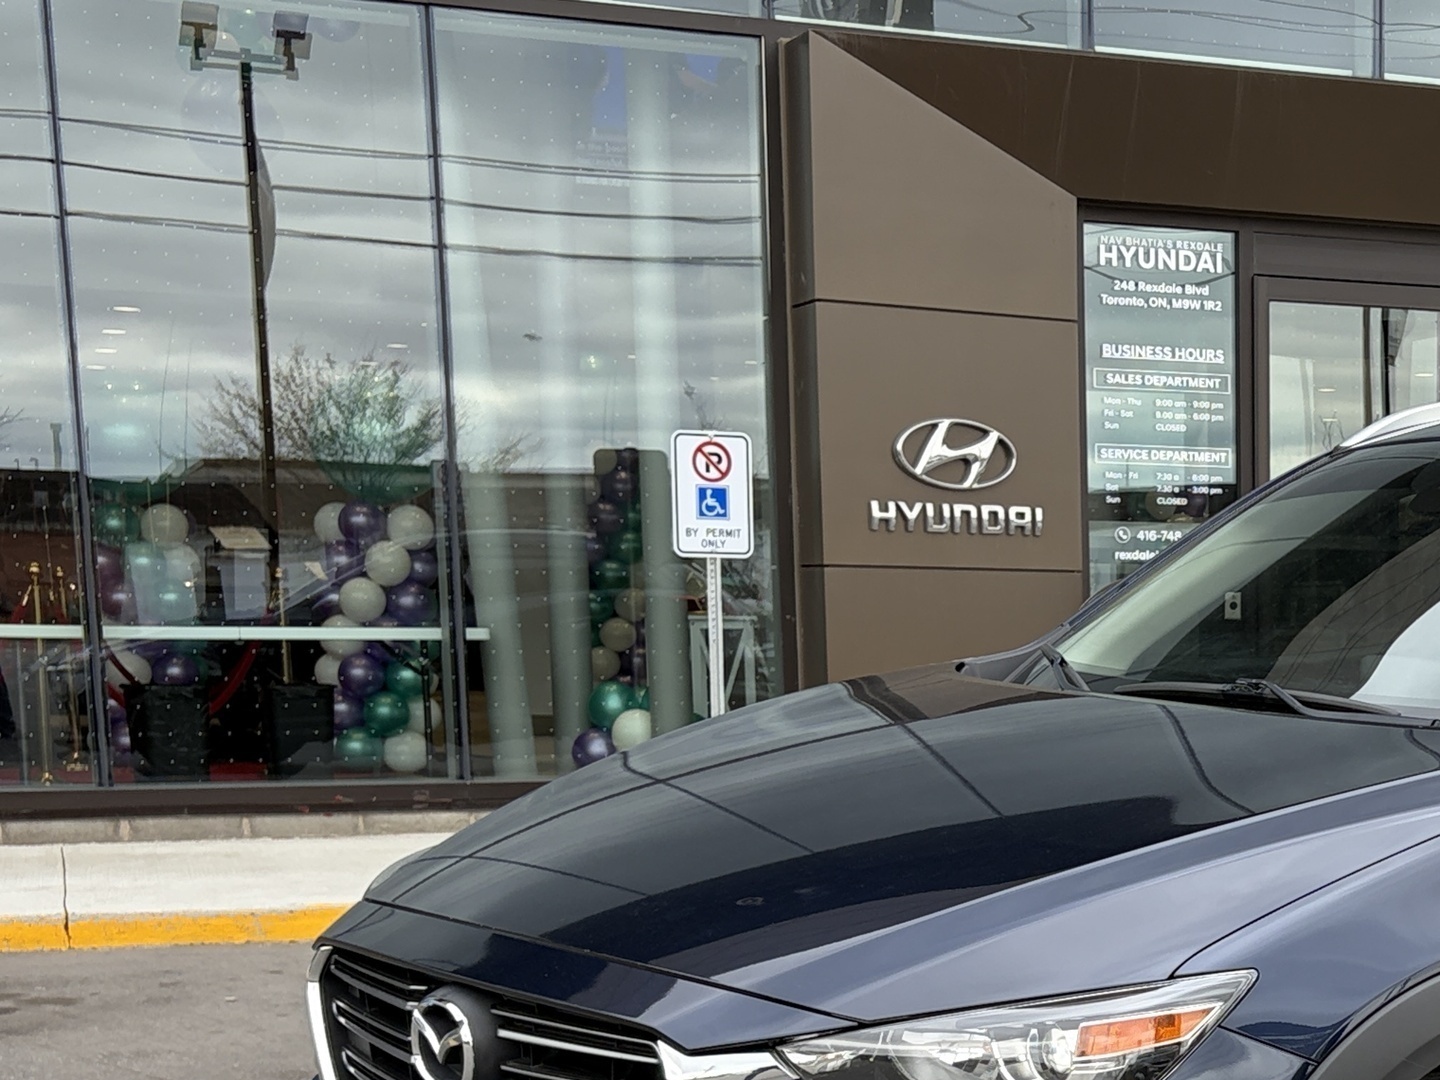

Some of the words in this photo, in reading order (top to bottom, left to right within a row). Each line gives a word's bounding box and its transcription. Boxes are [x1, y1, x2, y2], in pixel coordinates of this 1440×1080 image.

[1100, 235, 1123, 246] NAV
[1125, 236, 1173, 249] BHATIA'S
[1176, 240, 1224, 252] REXDALE
[1100, 244, 1223, 274] HYUNDAI
[1113, 280, 1136, 292] 248
[1137, 281, 1183, 294] Rexdale
[1185, 284, 1210, 296] Blvd
[1100, 294, 1148, 309] Toronto,
[1149, 297, 1171, 310] ON,
[1172, 298, 1202, 311] M9W
[1203, 300, 1223, 312] 1R2
[1102, 343, 1173, 359] BUSINESS
[1174, 348, 1225, 362] HOURS
[1106, 372, 1143, 385] SALES
[1144, 375, 1222, 389] DEPARTMENT
[1104, 421, 1119, 430] Sun
[1155, 423, 1187, 433] CLOSED
[1100, 448, 1149, 460] SERVICE
[1150, 450, 1227, 463] DEPARTMENT
[1156, 497, 1188, 506] CLOSED
[868, 499, 1044, 537] HYUNDAI
[685, 526, 699, 538] BY
[706, 527, 742, 539] PERMIT
[1136, 530, 1183, 542] 416-748
[701, 538, 727, 549] ONLY
[1114, 549, 1160, 561] rexdale
